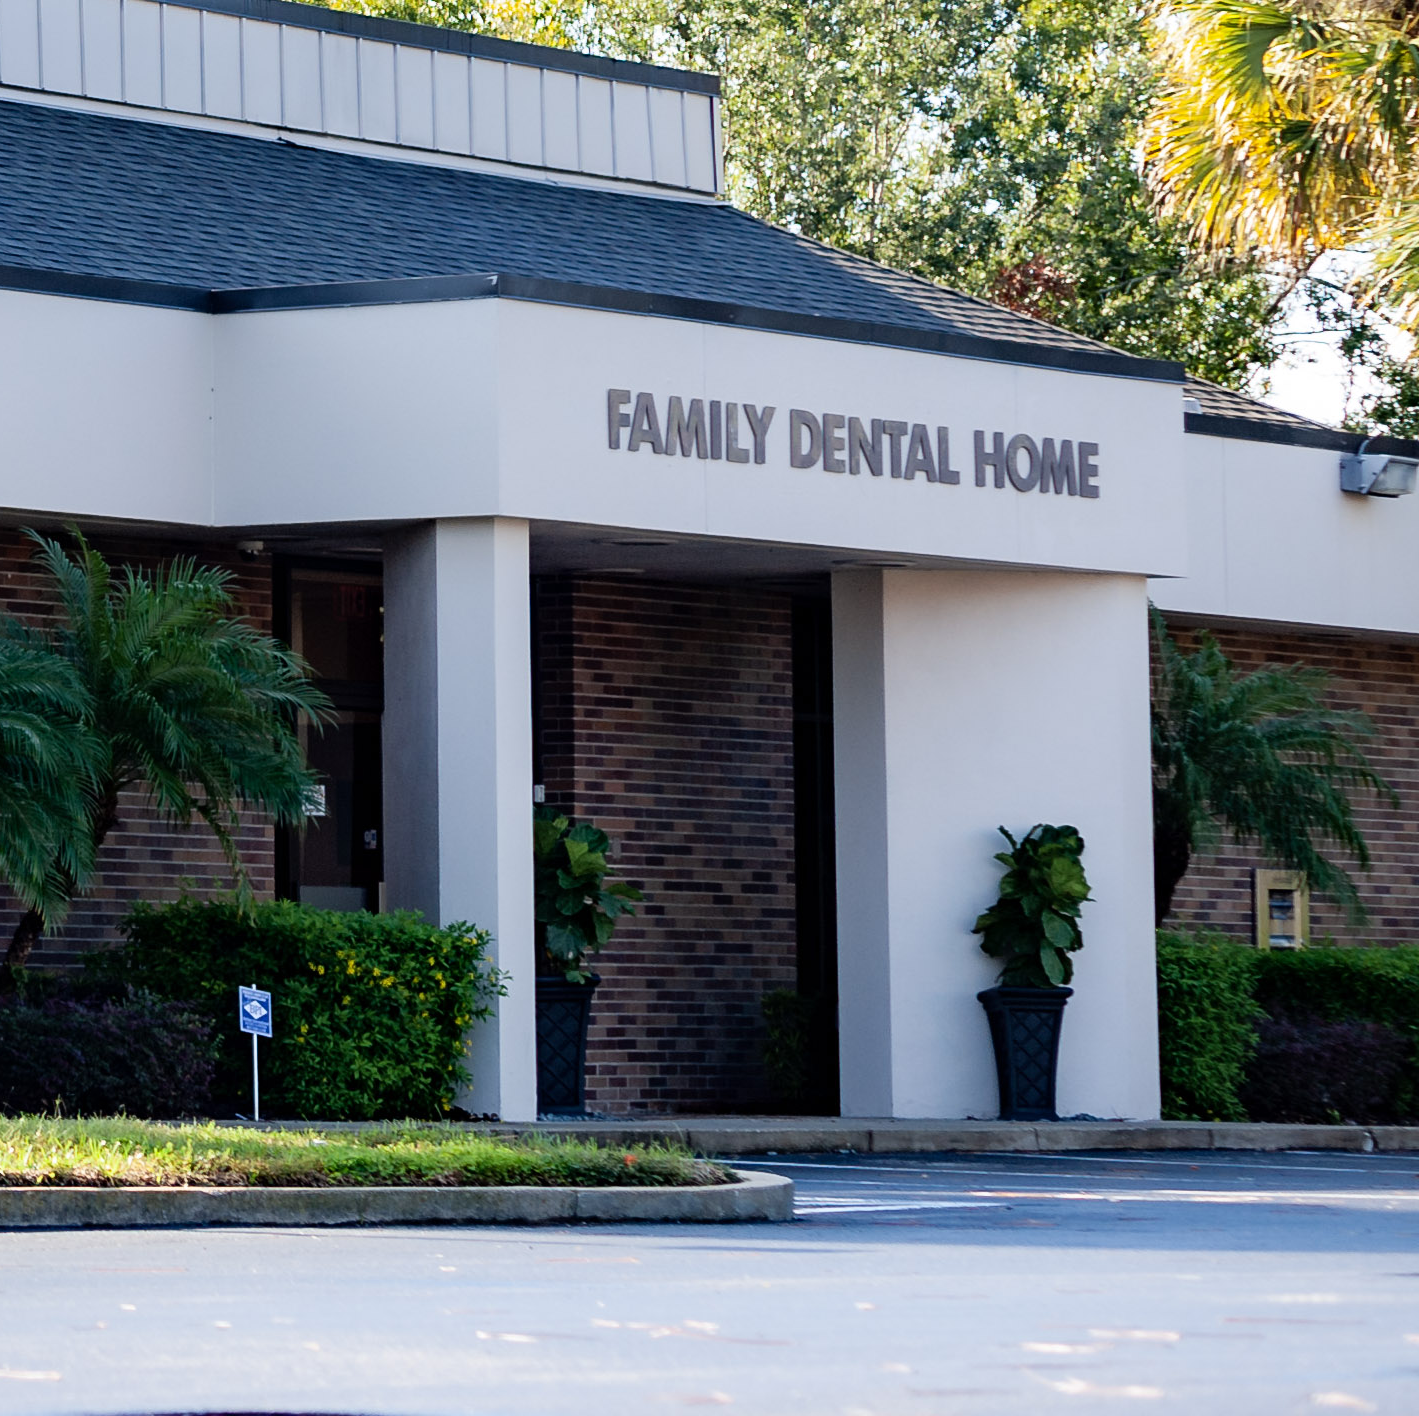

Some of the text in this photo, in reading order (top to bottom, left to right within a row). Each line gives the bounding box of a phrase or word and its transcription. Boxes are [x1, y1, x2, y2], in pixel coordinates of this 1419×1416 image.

[607, 388, 1100, 499] FAMILY DENTAL HOME
